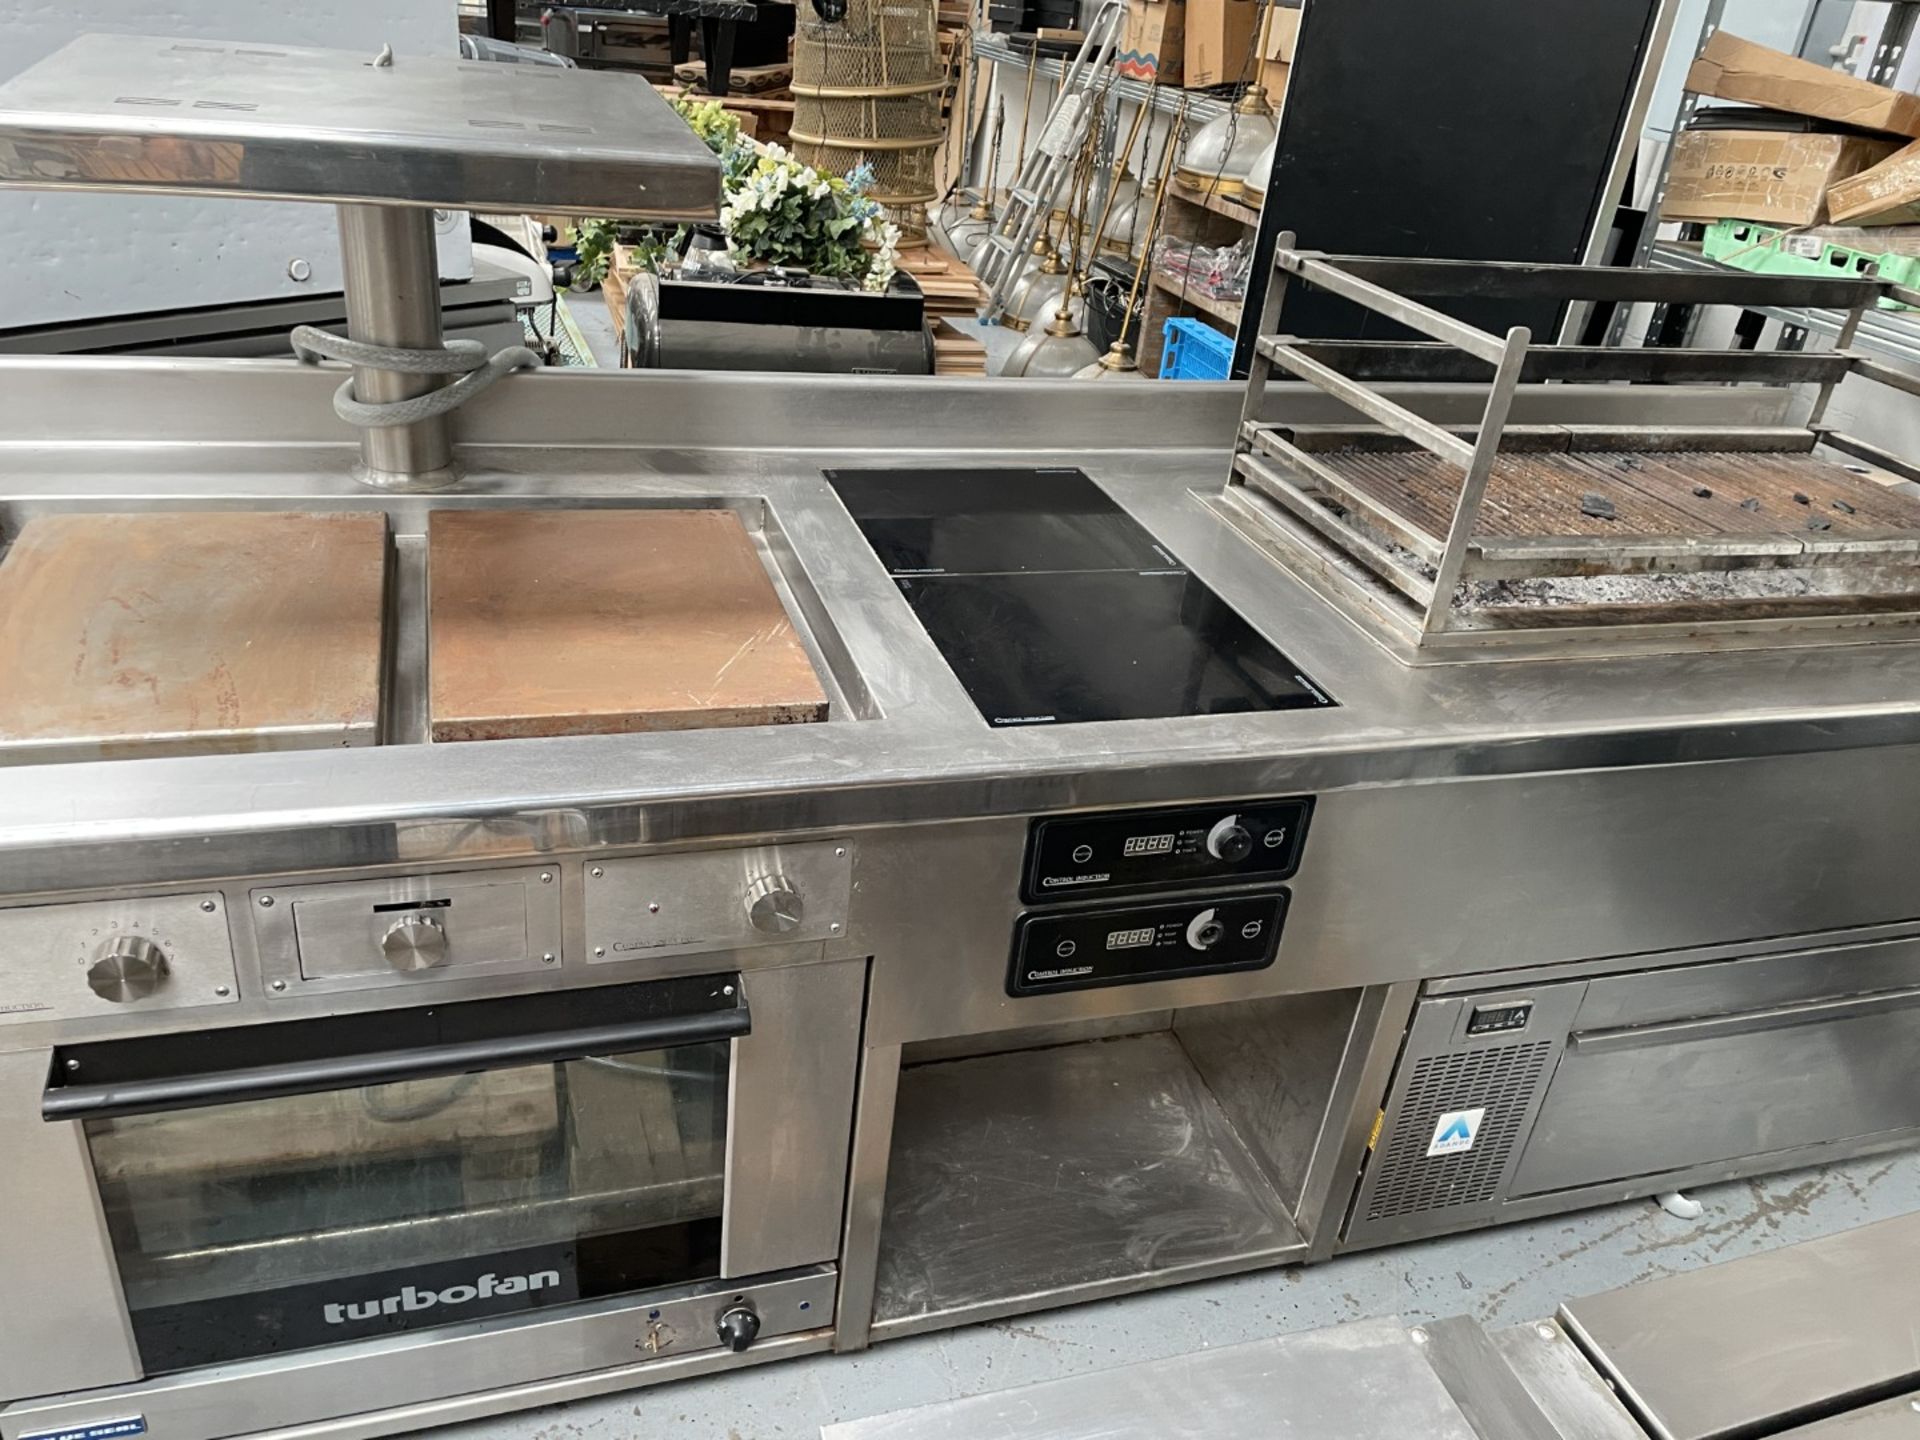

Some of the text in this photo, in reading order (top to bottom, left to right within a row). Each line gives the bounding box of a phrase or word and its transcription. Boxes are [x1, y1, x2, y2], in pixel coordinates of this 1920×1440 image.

[111, 920, 118, 929] 3
[132, 921, 140, 929] 4
[152, 927, 159, 936] 5
[323, 1269, 561, 1325] turbofan
